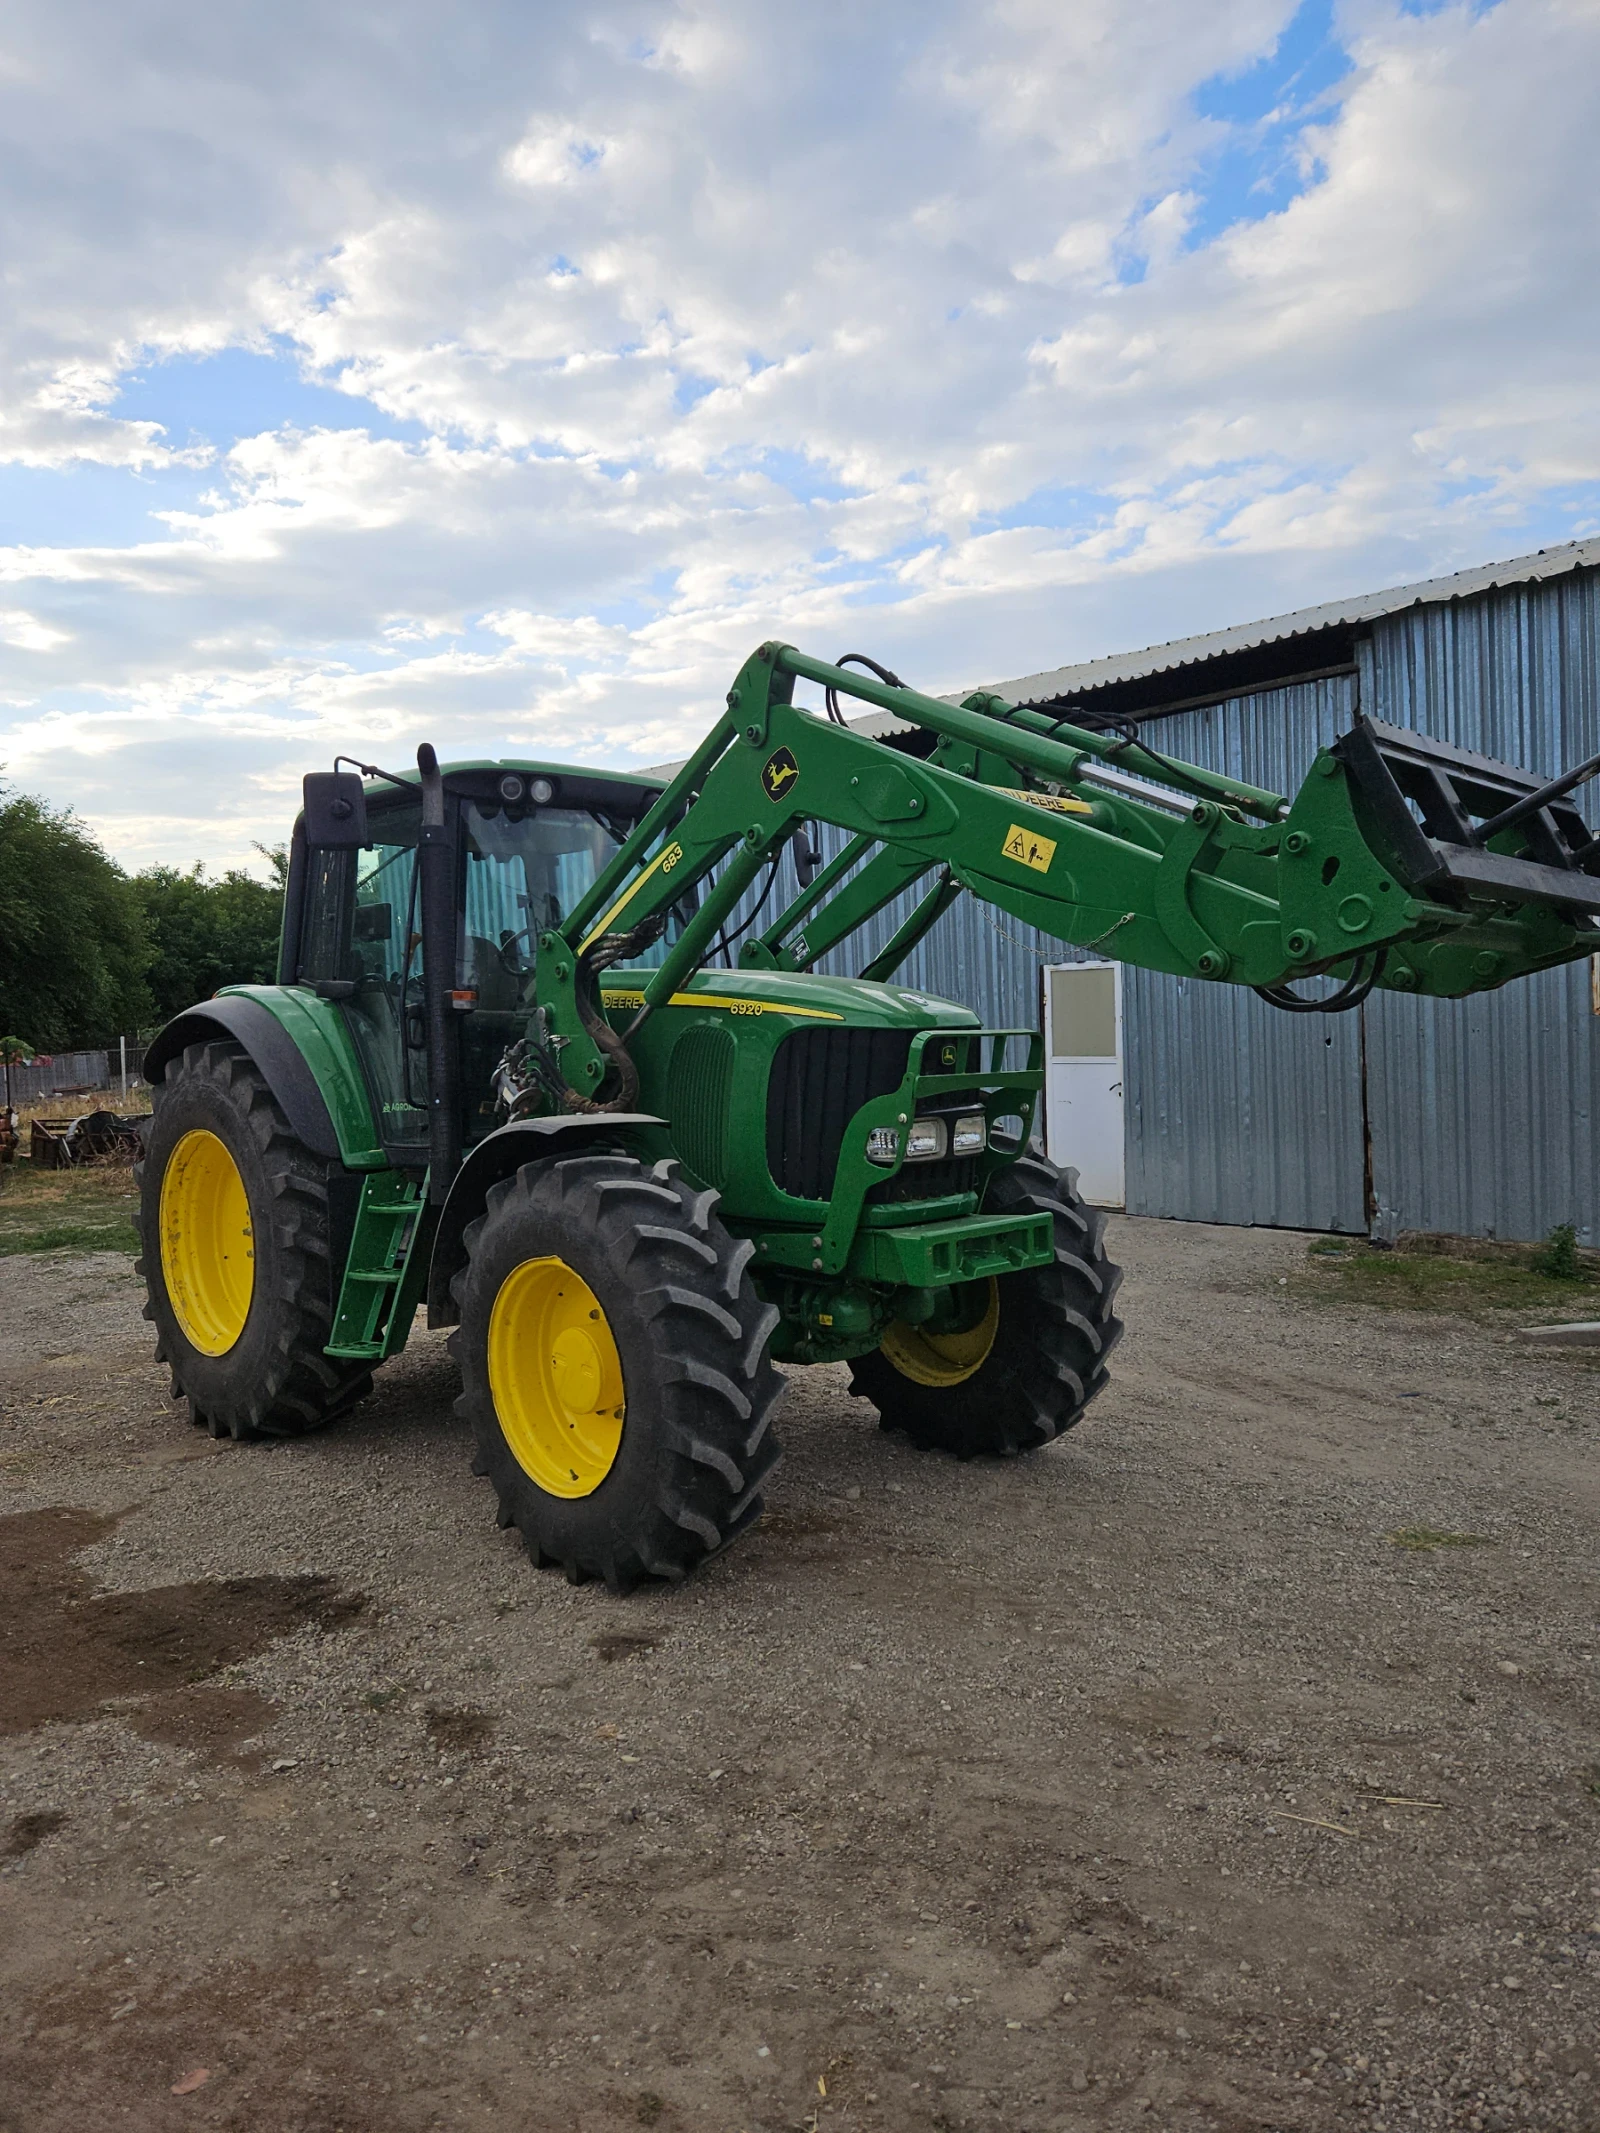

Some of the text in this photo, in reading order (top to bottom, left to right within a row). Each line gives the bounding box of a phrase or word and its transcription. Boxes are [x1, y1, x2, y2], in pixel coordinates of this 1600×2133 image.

[662, 845, 683, 873] 683
[603, 994, 640, 1009] DEERE
[730, 1002, 763, 1016] 6920
